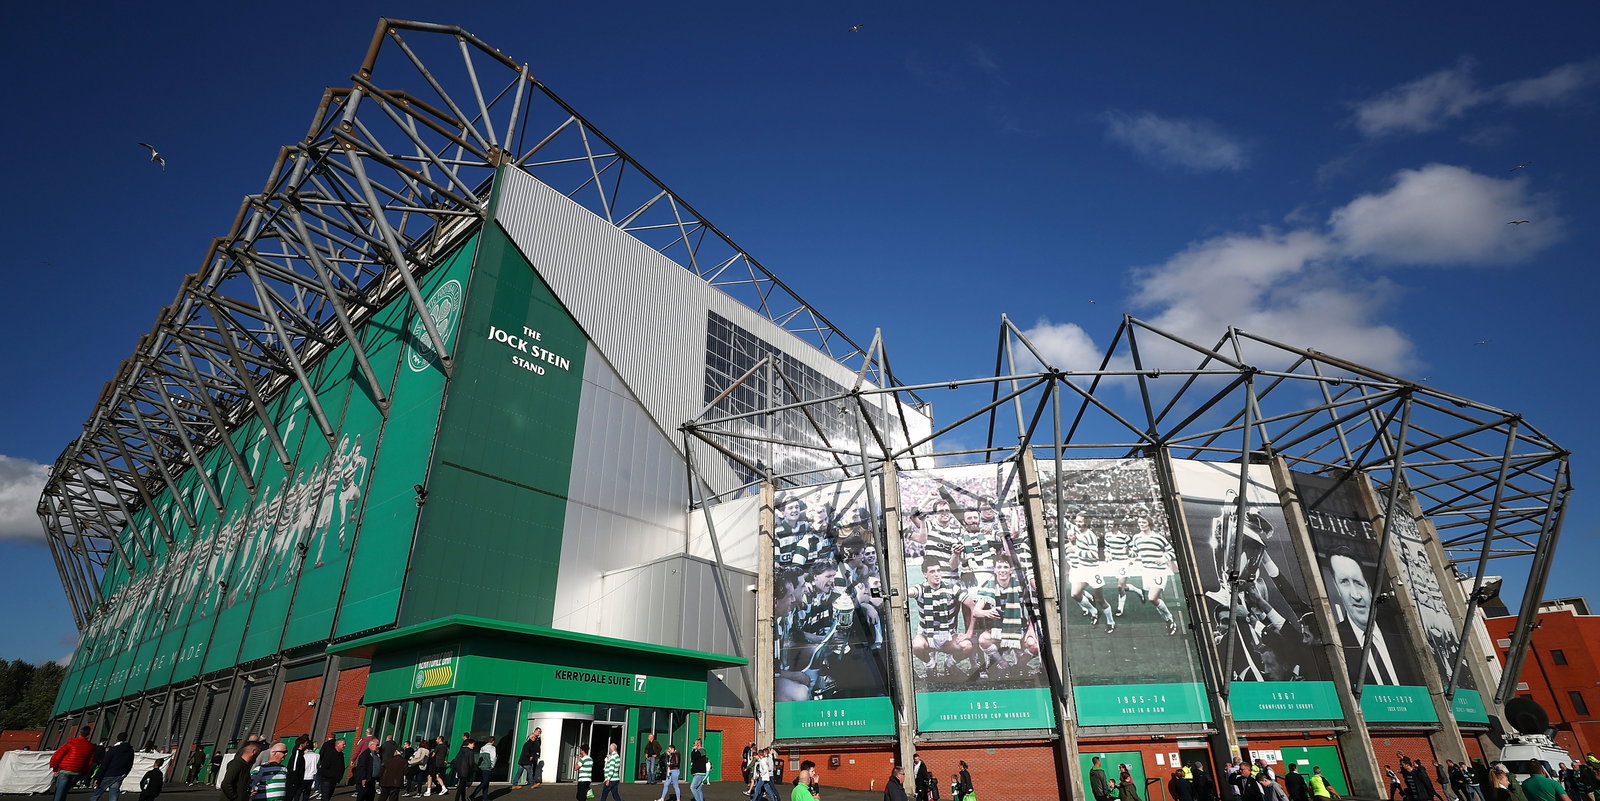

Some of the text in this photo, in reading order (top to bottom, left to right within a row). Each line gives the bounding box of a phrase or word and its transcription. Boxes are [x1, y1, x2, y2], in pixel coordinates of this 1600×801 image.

[523, 326, 542, 342] THE
[488, 325, 570, 371] JOCK STEIN
[512, 355, 545, 376] STAND
[1094, 574, 1103, 585] 8
[169, 642, 203, 666] MADE
[555, 669, 645, 691] KERRYDALE SUITE 7
[1272, 692, 1295, 700] 1967
[821, 709, 845, 718] 1988
[970, 701, 997, 710] 1985
